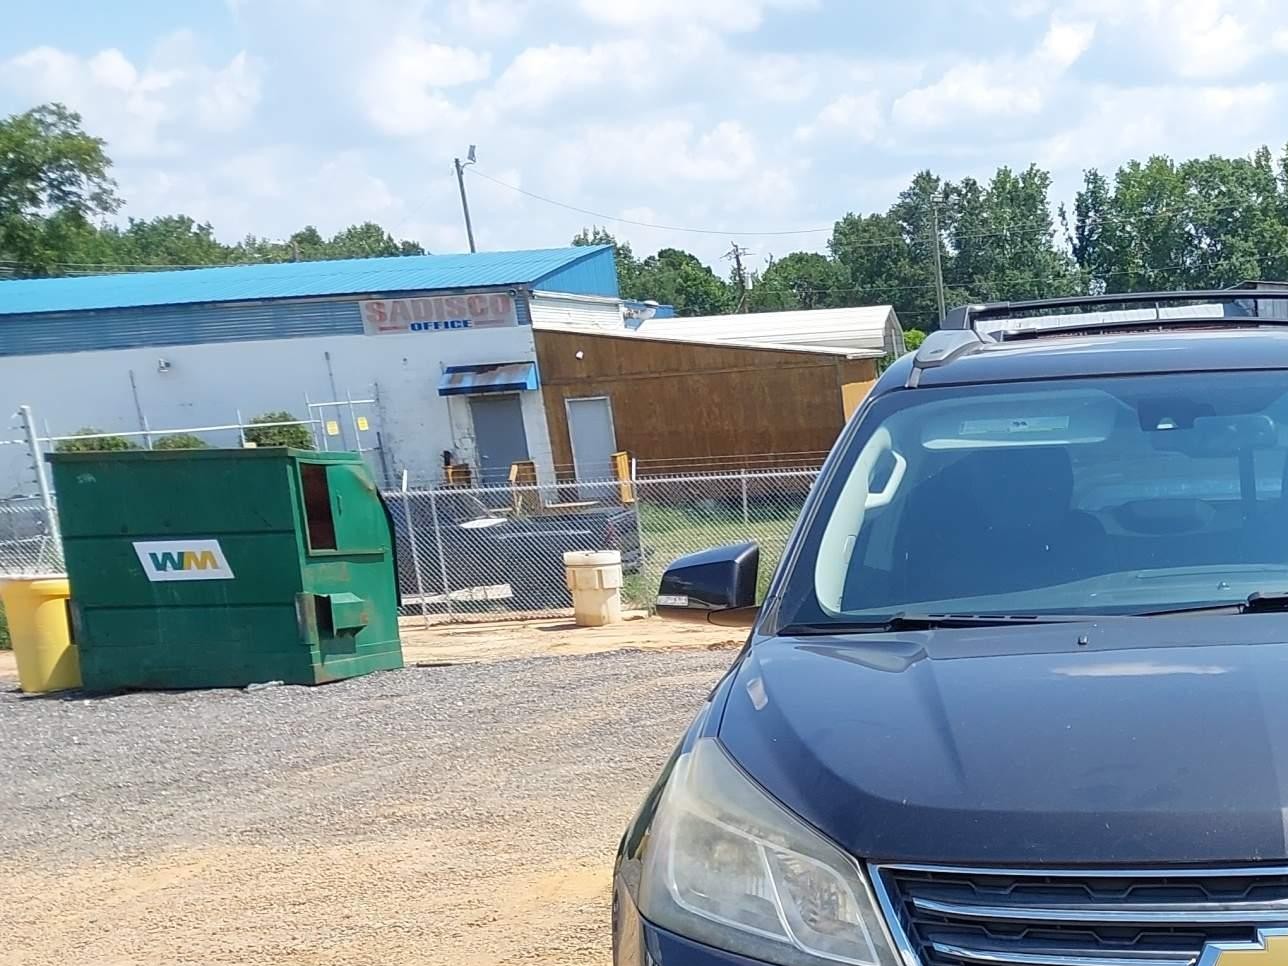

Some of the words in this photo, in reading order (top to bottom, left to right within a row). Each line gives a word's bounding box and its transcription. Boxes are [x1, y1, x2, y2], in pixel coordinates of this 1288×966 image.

[365, 294, 512, 322] SADISCO
[410, 319, 473, 332] OFFICE
[148, 550, 220, 572] WM
